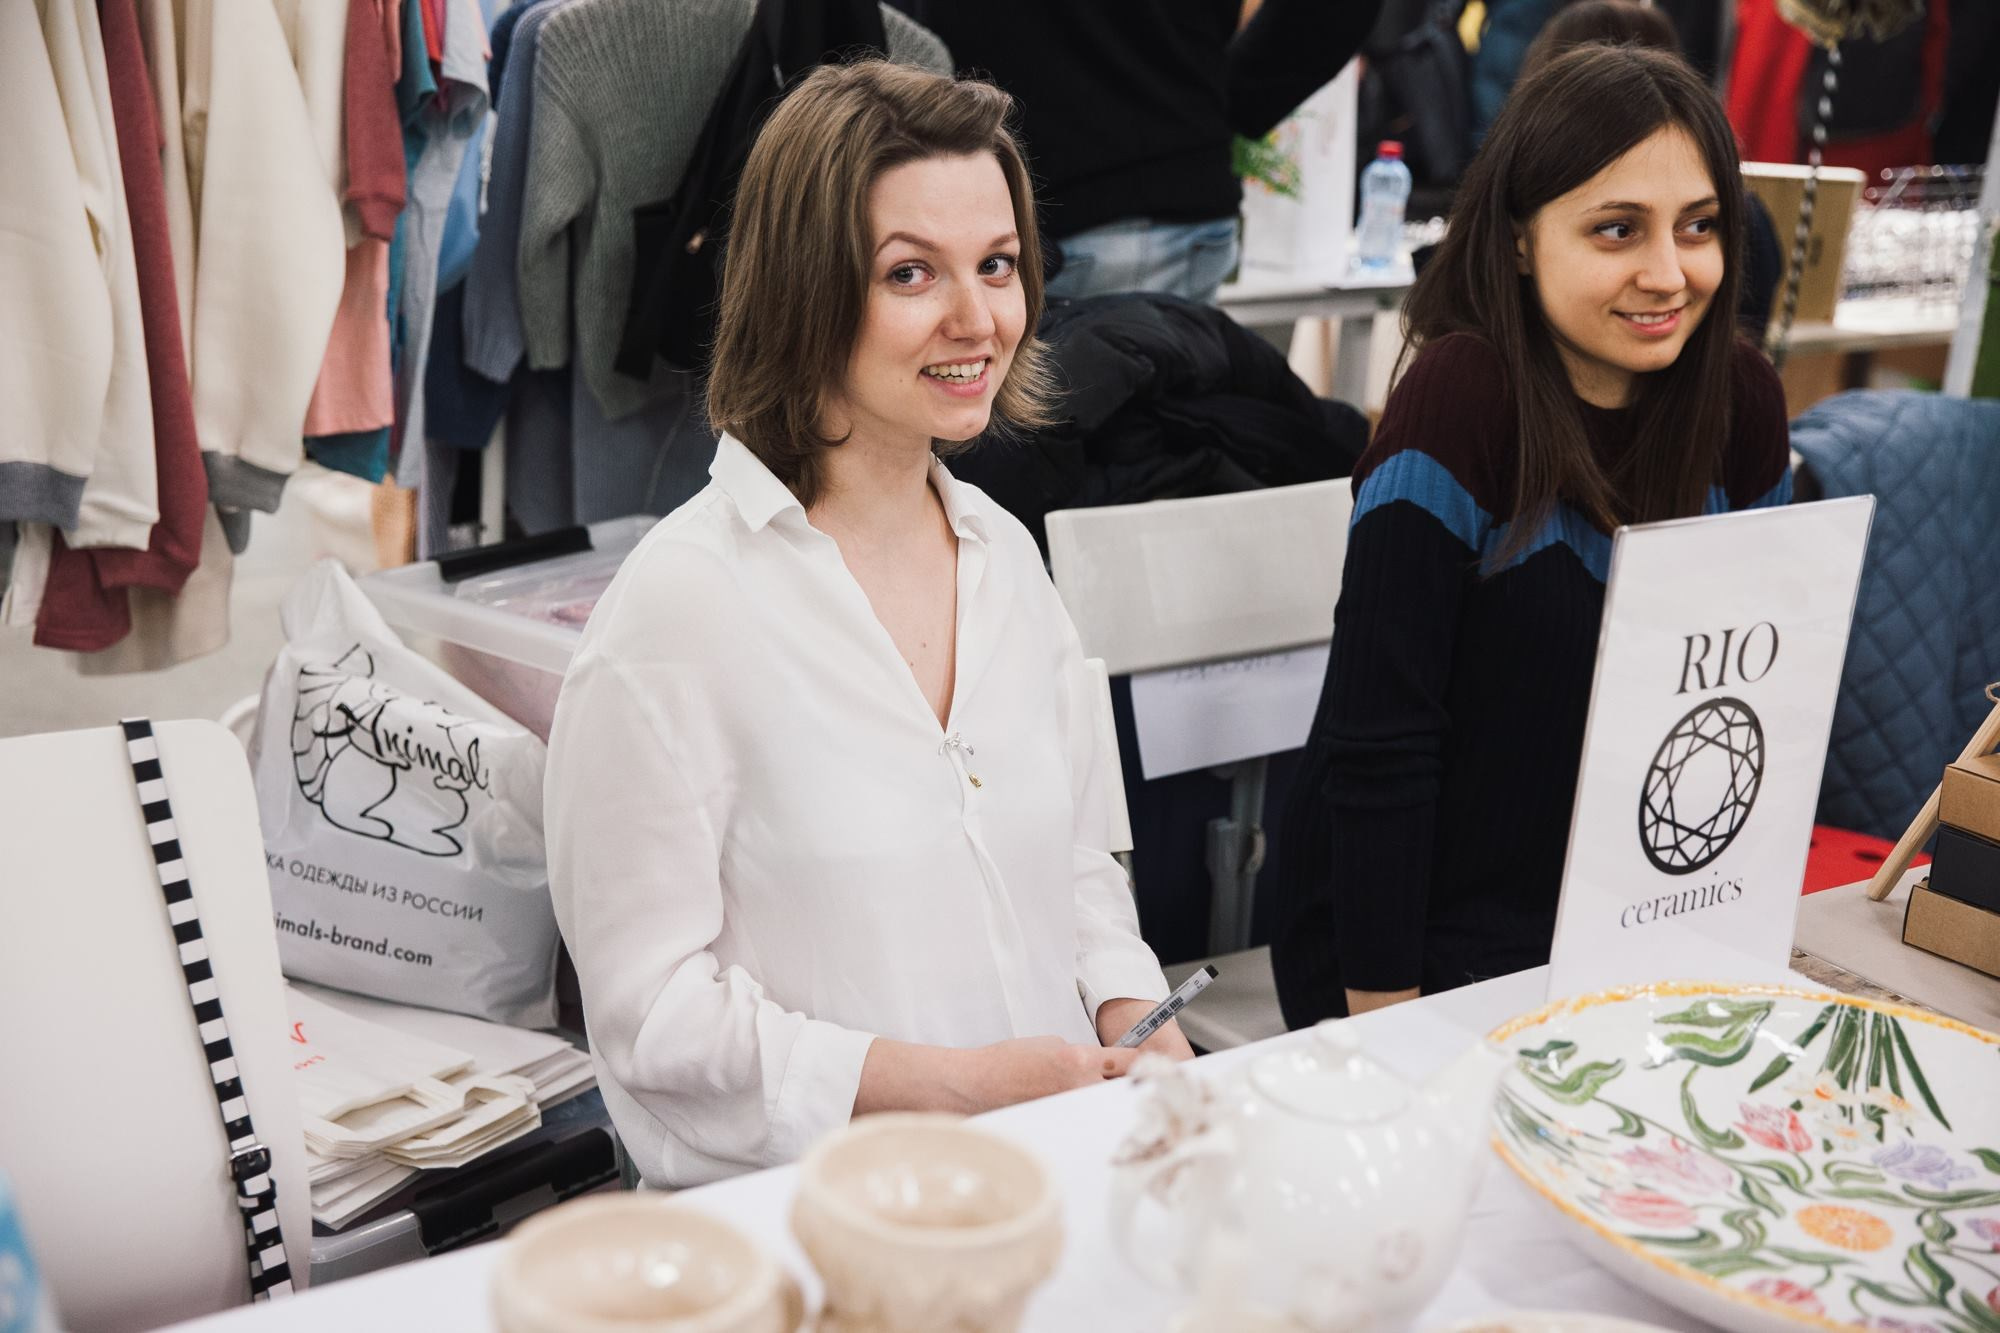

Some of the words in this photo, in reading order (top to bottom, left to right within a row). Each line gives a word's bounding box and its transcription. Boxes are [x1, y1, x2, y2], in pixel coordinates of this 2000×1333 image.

[1674, 621, 1780, 695] RIO
[312, 697, 494, 799] Animal
[264, 848, 285, 872] КА
[289, 860, 368, 894] ОДЕЖДЫ
[372, 883, 398, 902] ИЗ
[401, 890, 484, 922] РОССИИ
[1620, 871, 1744, 928] ceramics
[273, 911, 434, 967] imals-brand.com
